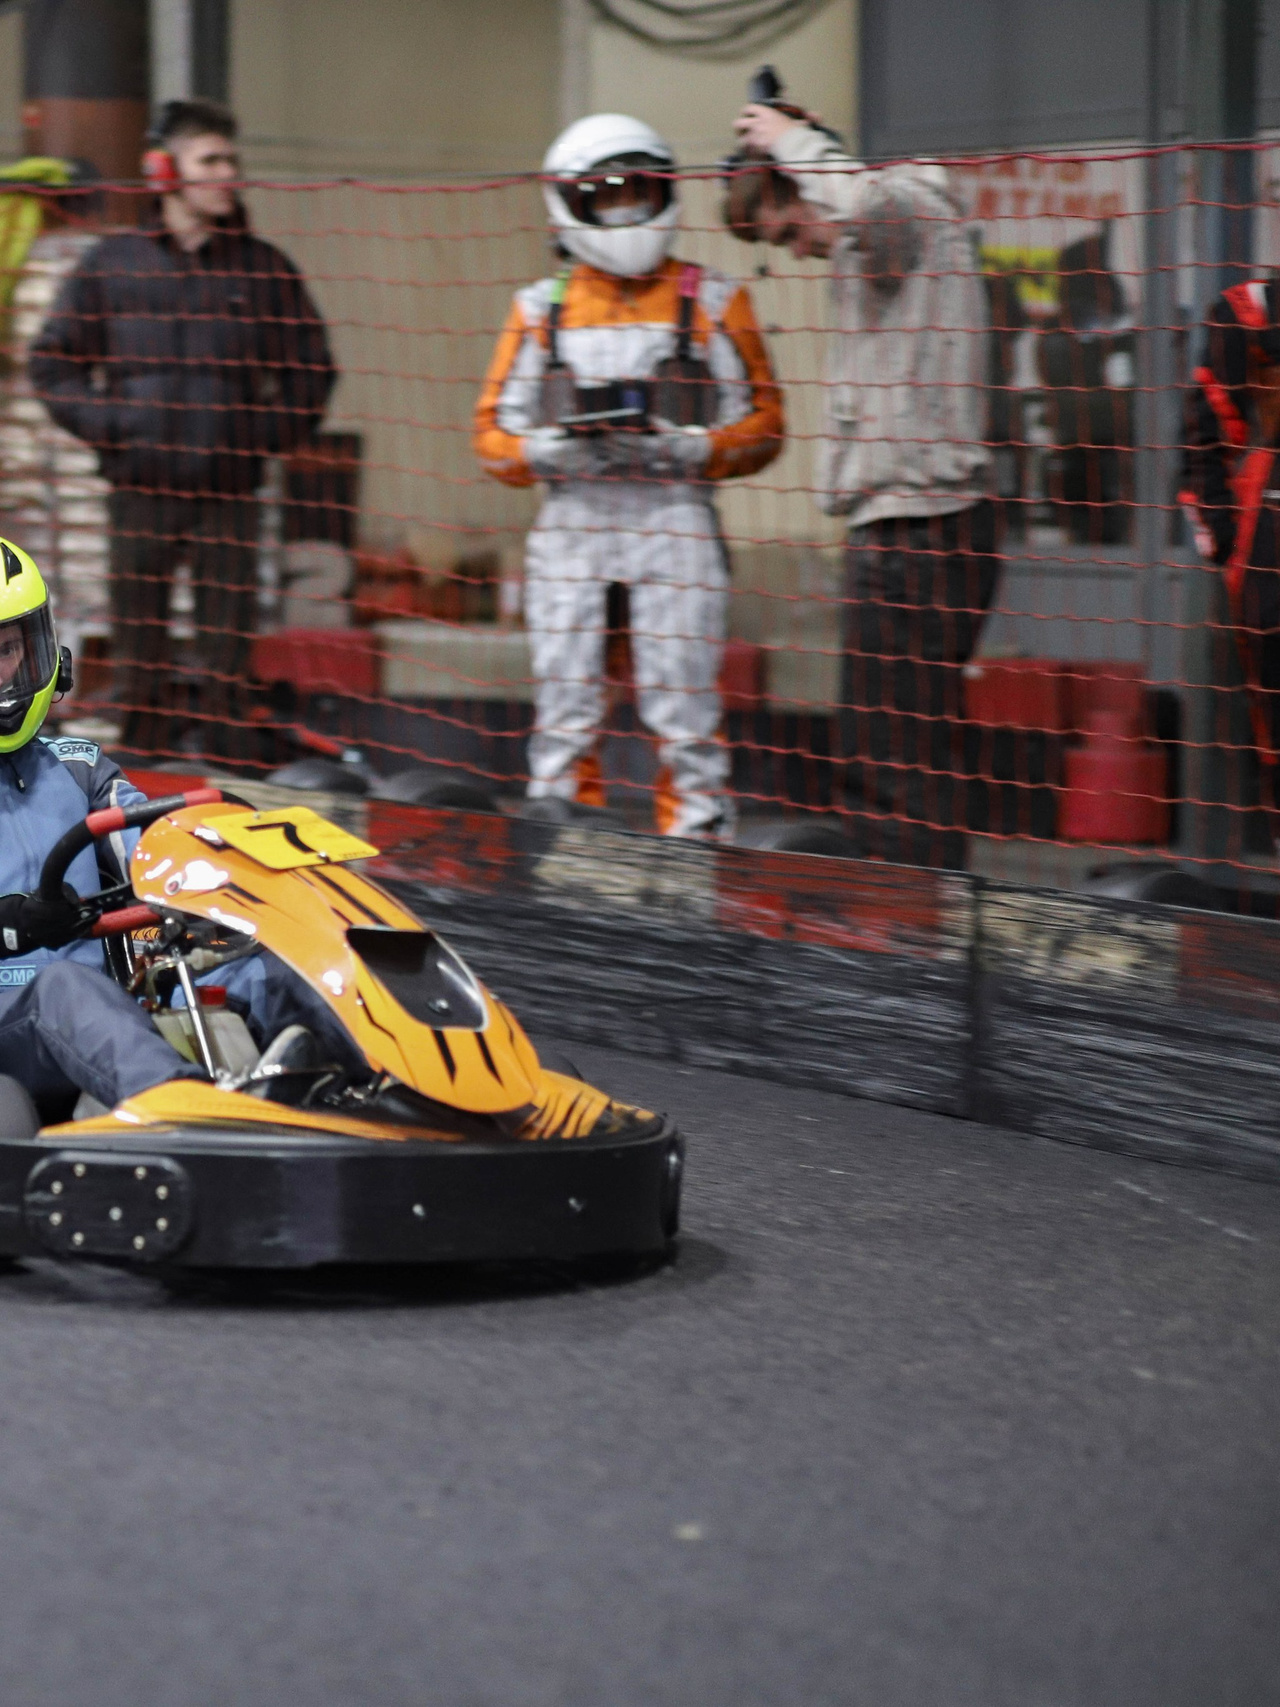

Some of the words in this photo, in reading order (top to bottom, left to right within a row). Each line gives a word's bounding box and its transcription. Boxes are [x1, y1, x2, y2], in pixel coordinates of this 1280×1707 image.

[59, 745, 94, 756] OMP
[244, 821, 315, 853] 7
[0, 969, 36, 983] OMP
